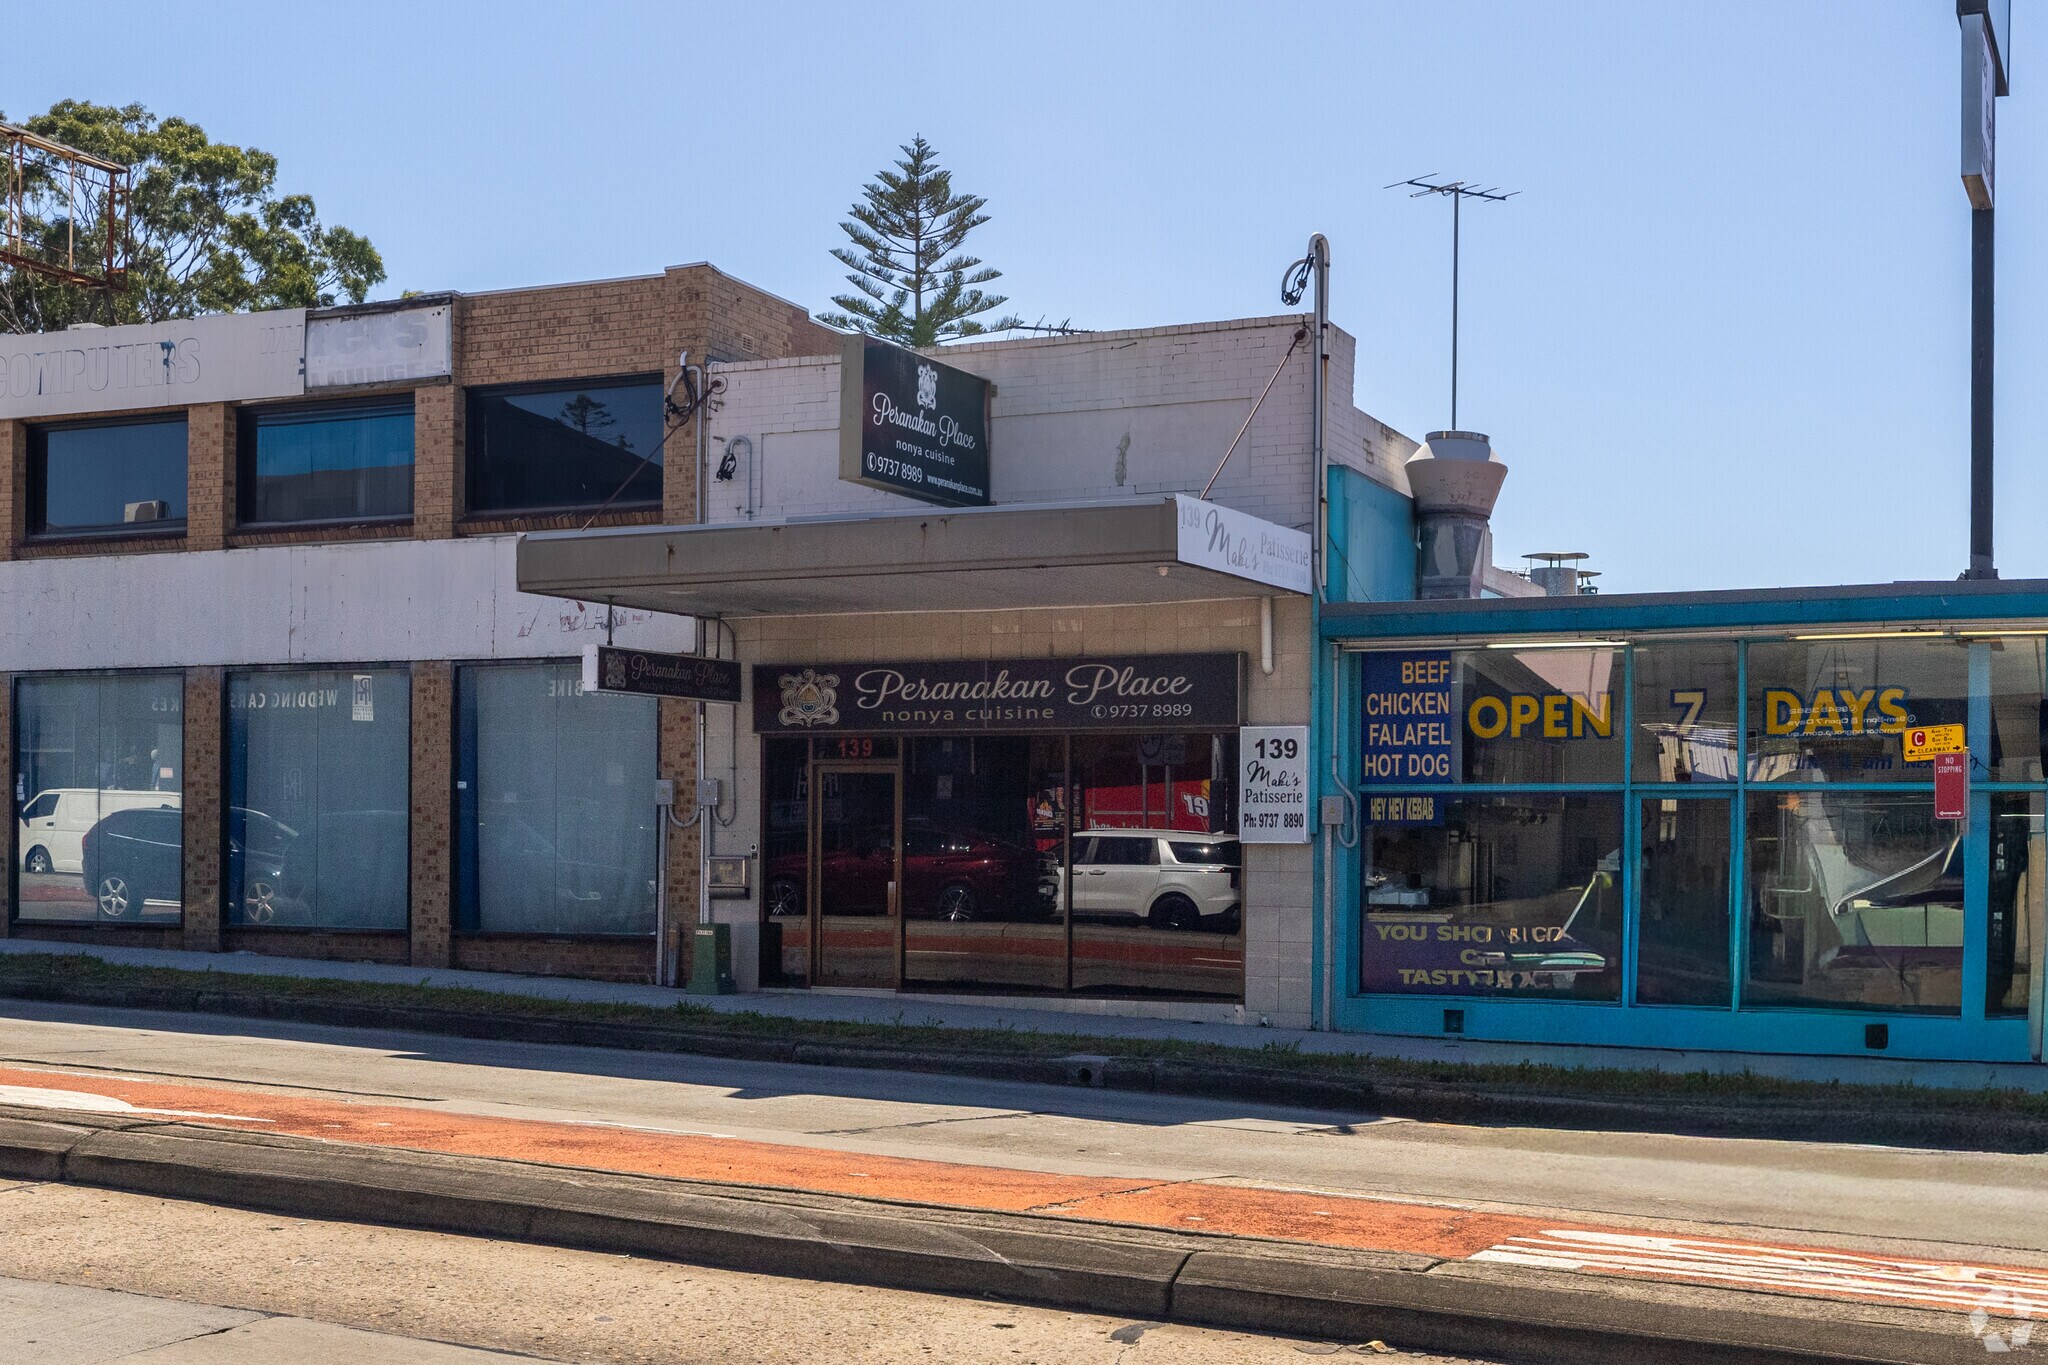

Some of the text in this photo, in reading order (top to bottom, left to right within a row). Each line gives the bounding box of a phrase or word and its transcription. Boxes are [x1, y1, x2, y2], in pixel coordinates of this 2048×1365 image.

[872, 392, 976, 450] Peranakan Place
[895, 439, 955, 466] nonya cuisine
[877, 456, 900, 477] 9737
[901, 463, 923, 483] 8989
[1180, 503, 1201, 529] 139
[1260, 531, 1309, 567] Patisserie
[631, 654, 692, 681] Peranakan
[1402, 661, 1450, 684] BEEF
[855, 664, 1193, 709] Peranakan Place
[883, 704, 1192, 724] nonya cuisine 9737 8989
[1366, 692, 1449, 715] CHICKEN
[1466, 688, 1909, 739] OPEN 7 DAYS
[1369, 723, 1451, 746] FALAFEL
[1914, 732, 1923, 746] C
[839, 738, 873, 757] 139
[1255, 738, 1298, 759] 139
[1917, 746, 1950, 754] CLEARWAY
[1365, 754, 1449, 776] HOT DOG
[1937, 765, 1962, 774] STOPPING
[1945, 756, 1955, 765] NO
[1246, 760, 1302, 788] Maki's
[1245, 788, 1303, 803] Patisserie
[1243, 813, 1304, 828] Ph: 9737 8890
[1370, 797, 1434, 821] HEY HEY KEBAB
[1375, 925, 1427, 941] YOU
